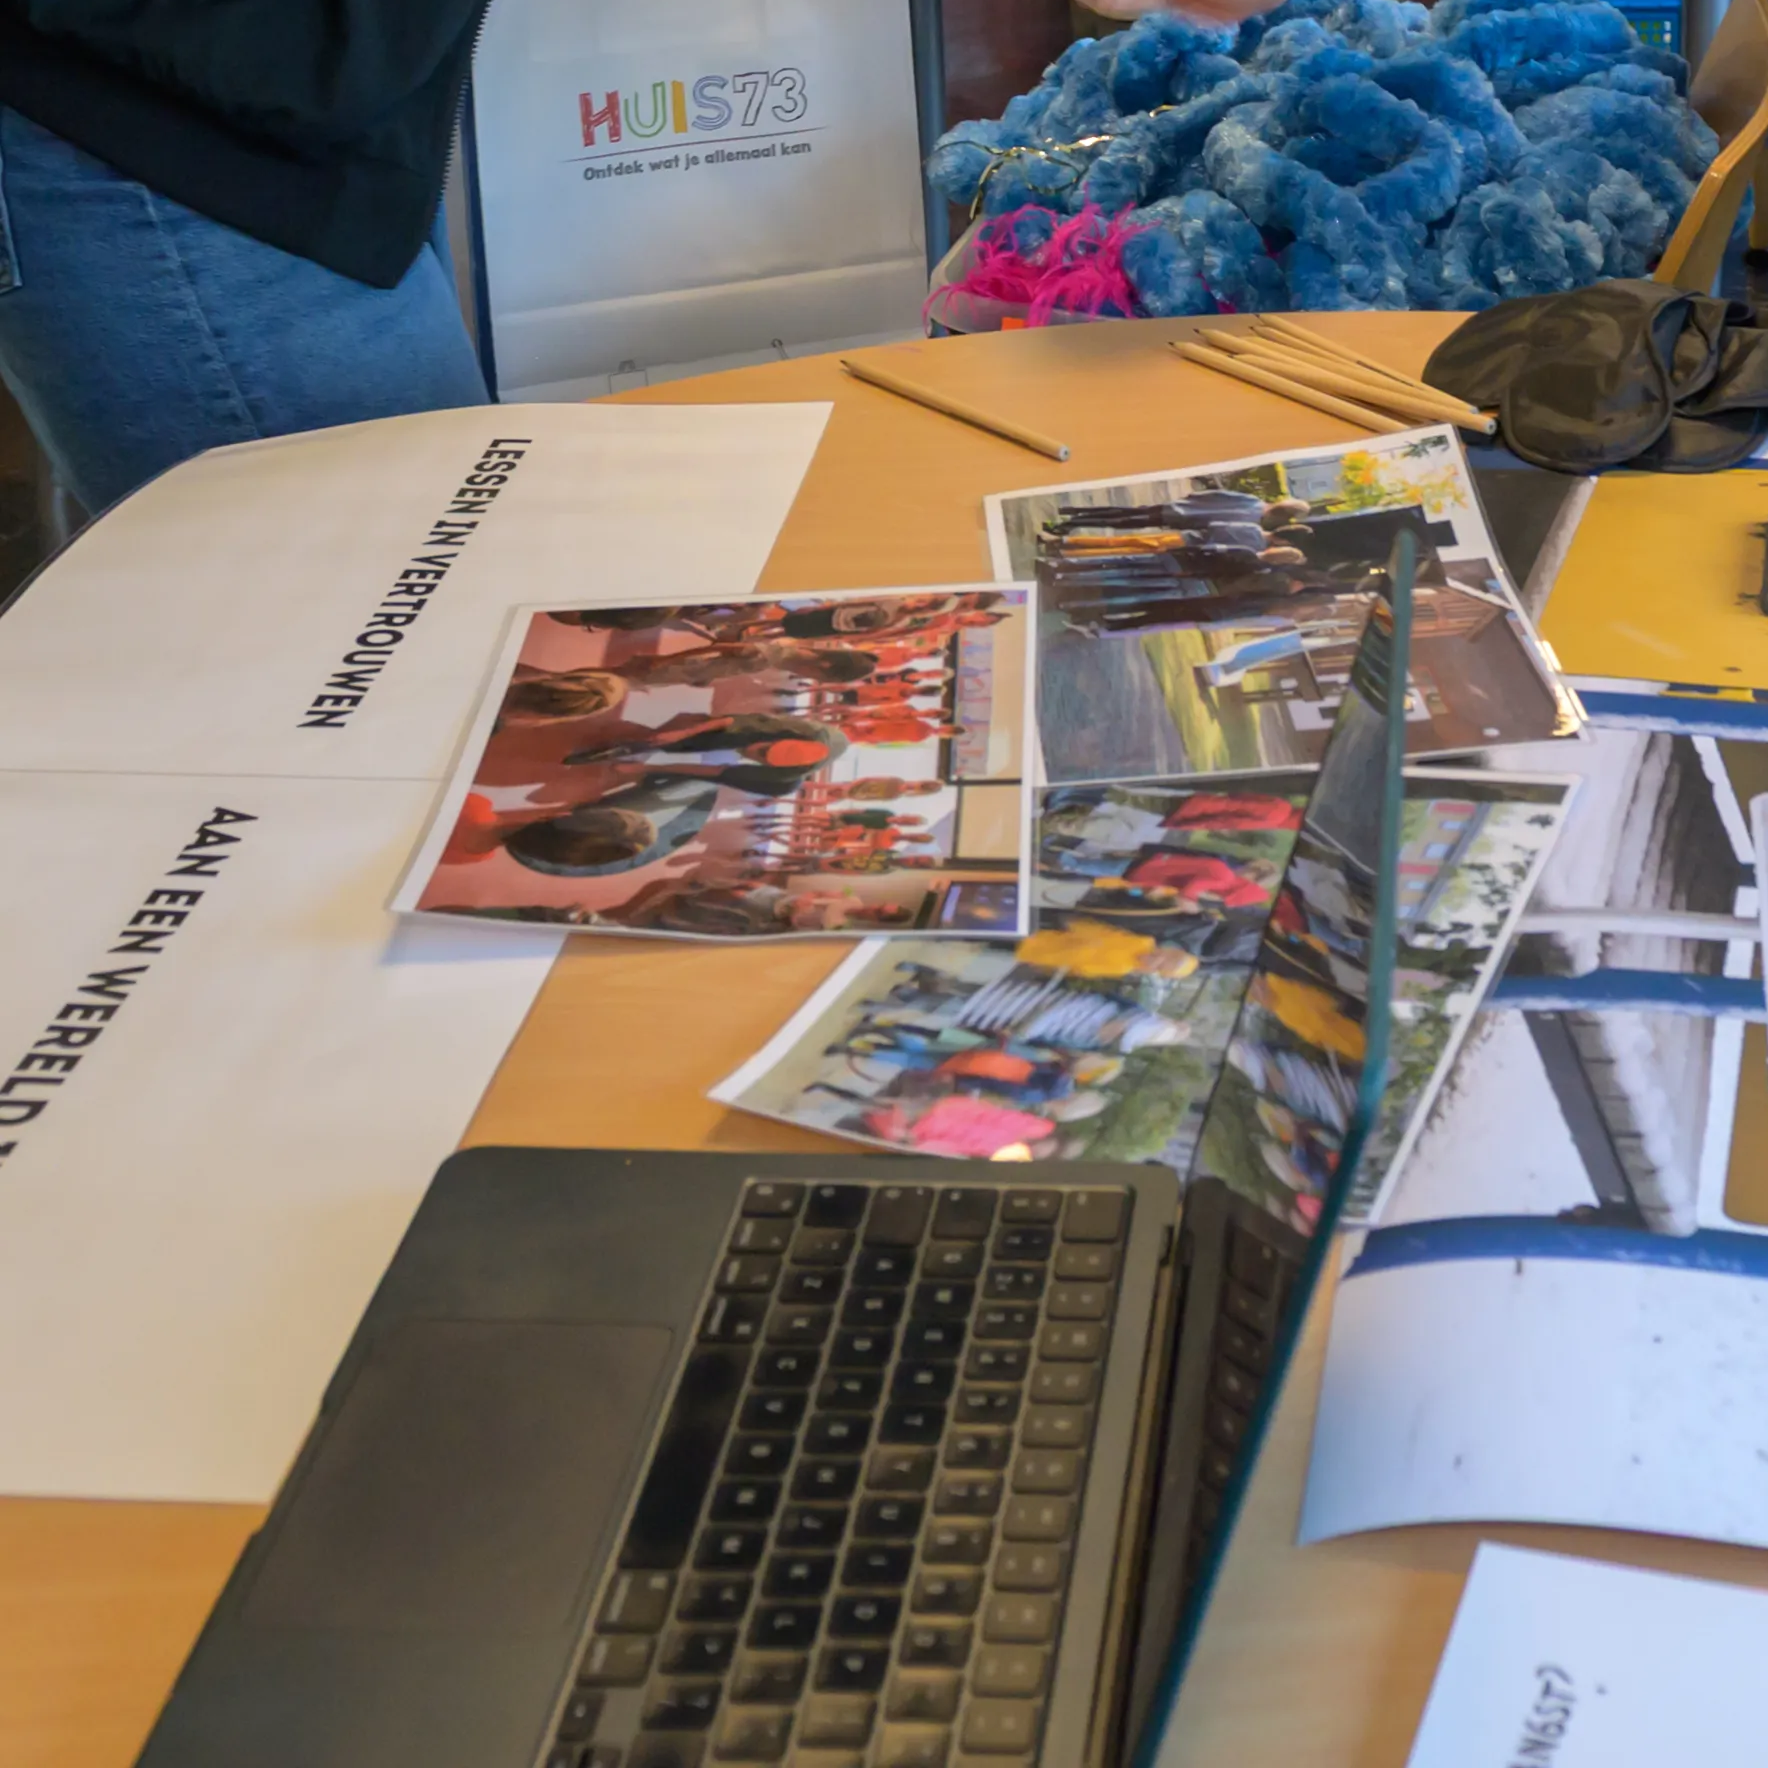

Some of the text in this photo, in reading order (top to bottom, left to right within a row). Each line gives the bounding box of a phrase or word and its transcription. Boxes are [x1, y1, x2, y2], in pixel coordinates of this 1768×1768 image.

[578, 67, 809, 148] HUIS73
[583, 140, 813, 182] Ontdek wat je allemaal kan
[296, 438, 533, 729] LESSEN IN VERTROUWEN
[0, 806, 260, 1127] AAN EEN WERELD
